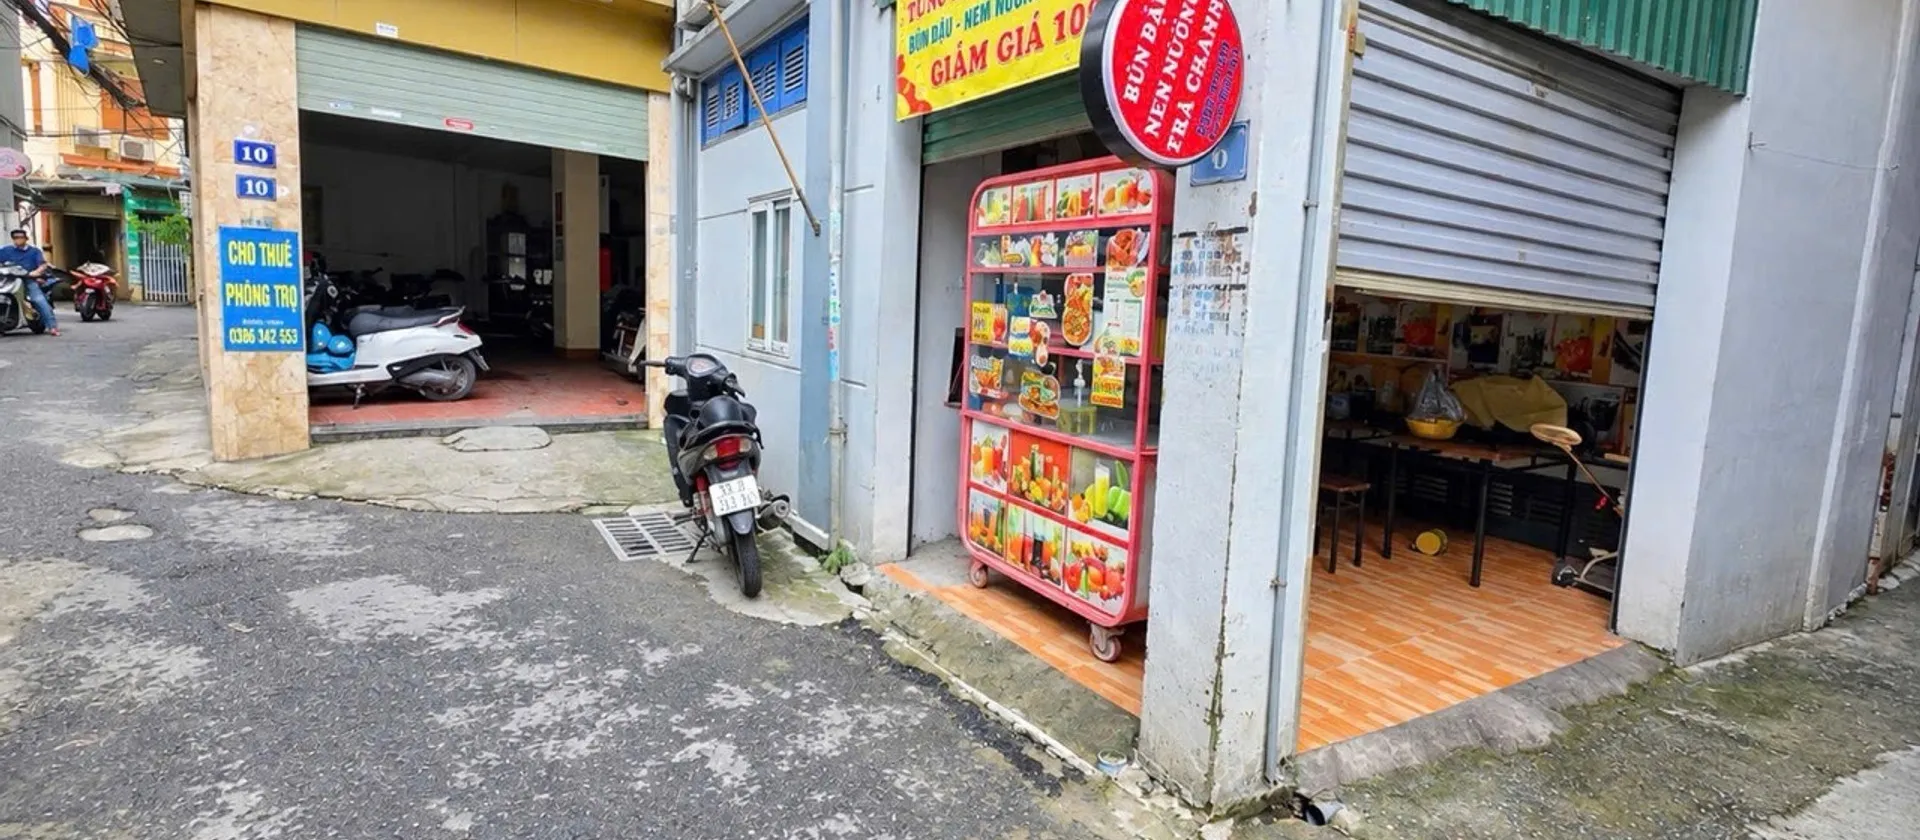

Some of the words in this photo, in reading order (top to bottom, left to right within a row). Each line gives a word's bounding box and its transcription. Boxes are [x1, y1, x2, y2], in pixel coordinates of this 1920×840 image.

[964, 1, 990, 31] NEM
[930, 39, 989, 87] GIẢM
[997, 10, 1044, 63] GIÁ
[1123, 44, 1151, 104] BÚN
[242, 145, 269, 164] 10
[245, 179, 269, 196] 10
[228, 240, 257, 266] CHO
[258, 239, 294, 269] THUÊ
[225, 279, 270, 308] PHÒNG
[273, 284, 299, 313] TRỌ
[257, 328, 278, 345] 342
